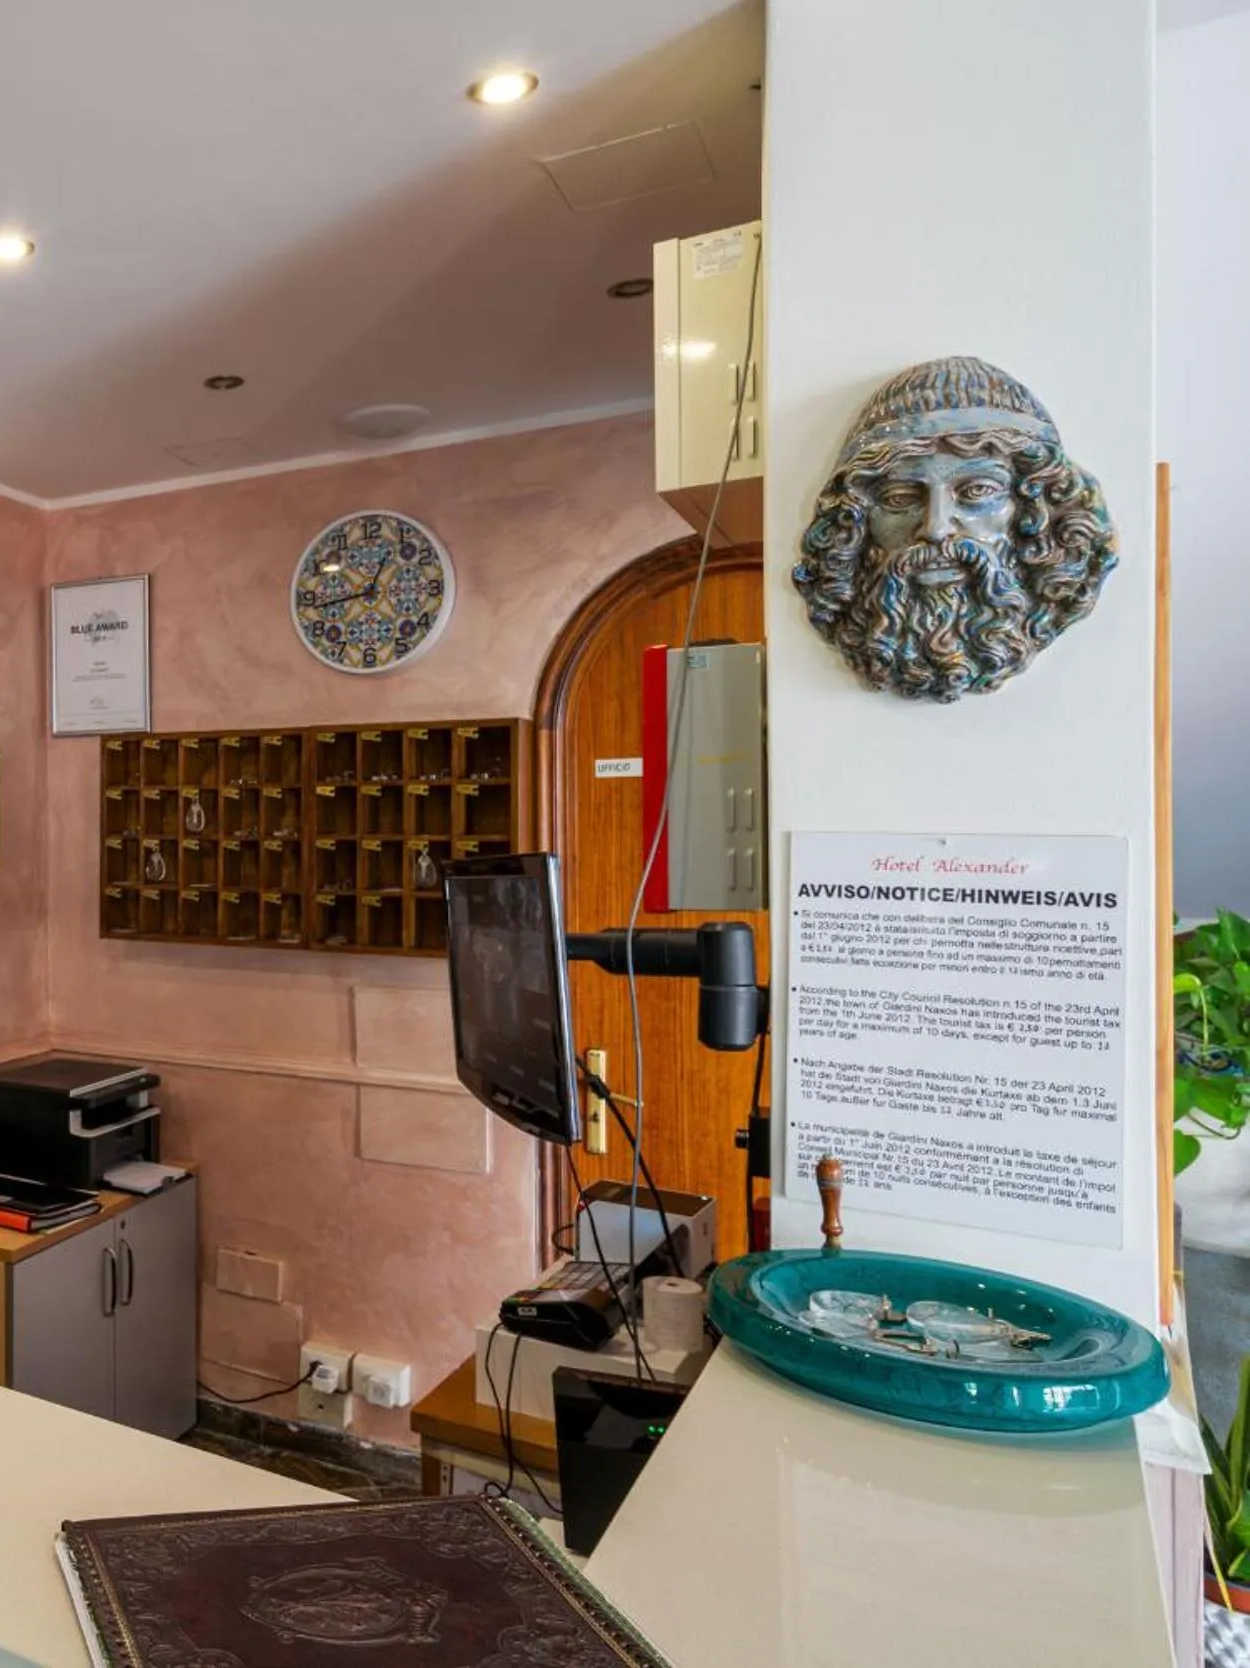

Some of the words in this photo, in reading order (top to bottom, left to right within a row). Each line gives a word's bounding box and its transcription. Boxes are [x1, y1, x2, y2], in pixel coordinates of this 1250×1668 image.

[362, 522, 382, 539] 12
[419, 549, 432, 565] 2
[428, 580, 441, 595] 3
[303, 591, 316, 606] 9
[417, 612, 429, 626] 4
[313, 621, 324, 636] 8
[336, 642, 347, 656] 7
[395, 638, 407, 652] 5
[363, 648, 376, 663] 6
[871, 854, 922, 872] Hotel
[931, 856, 1029, 875] Alexander
[798, 883, 1118, 909] AVVISO/NOTICE/HINWEIS/AVIS
